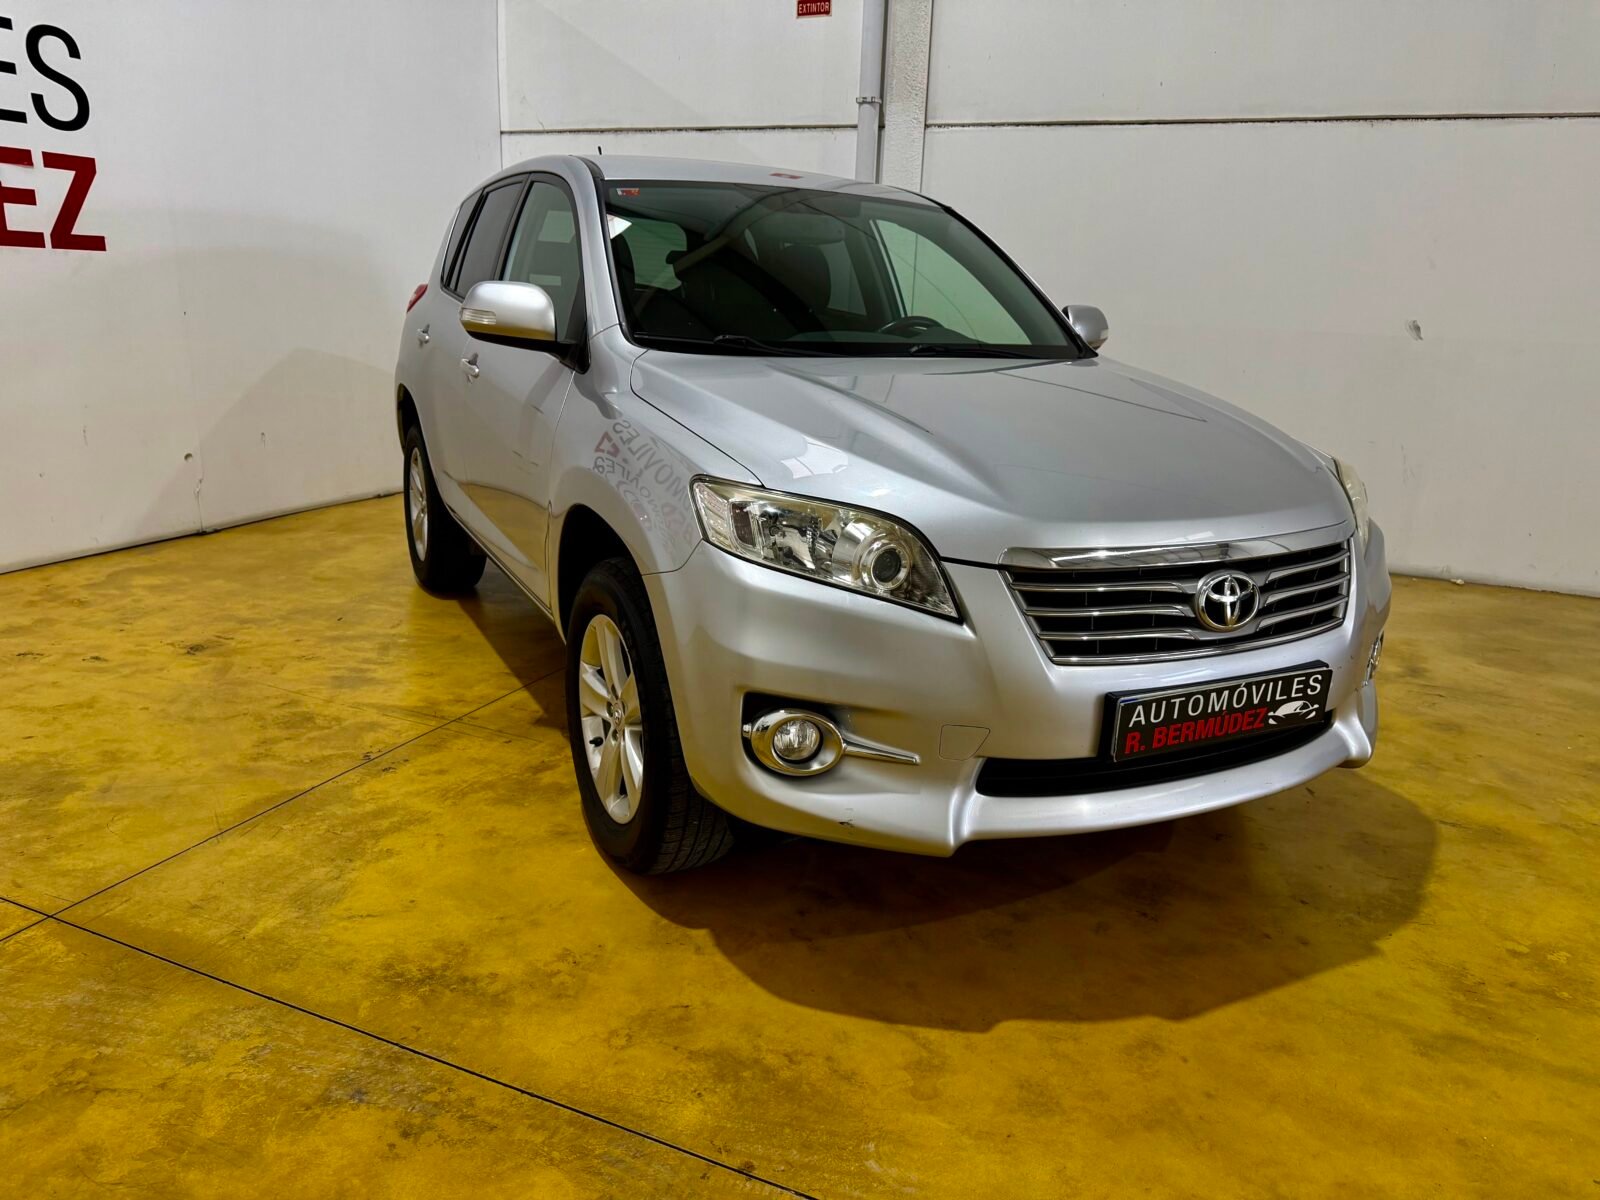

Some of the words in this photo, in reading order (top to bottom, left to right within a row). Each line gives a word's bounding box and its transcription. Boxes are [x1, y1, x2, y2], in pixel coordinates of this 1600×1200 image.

[798, 2, 830, 14] EXTINTOR
[1128, 673, 1323, 728] AUTOMÓVILES
[1124, 730, 1146, 755] R.
[1152, 706, 1270, 749] BERMÚDEZ
